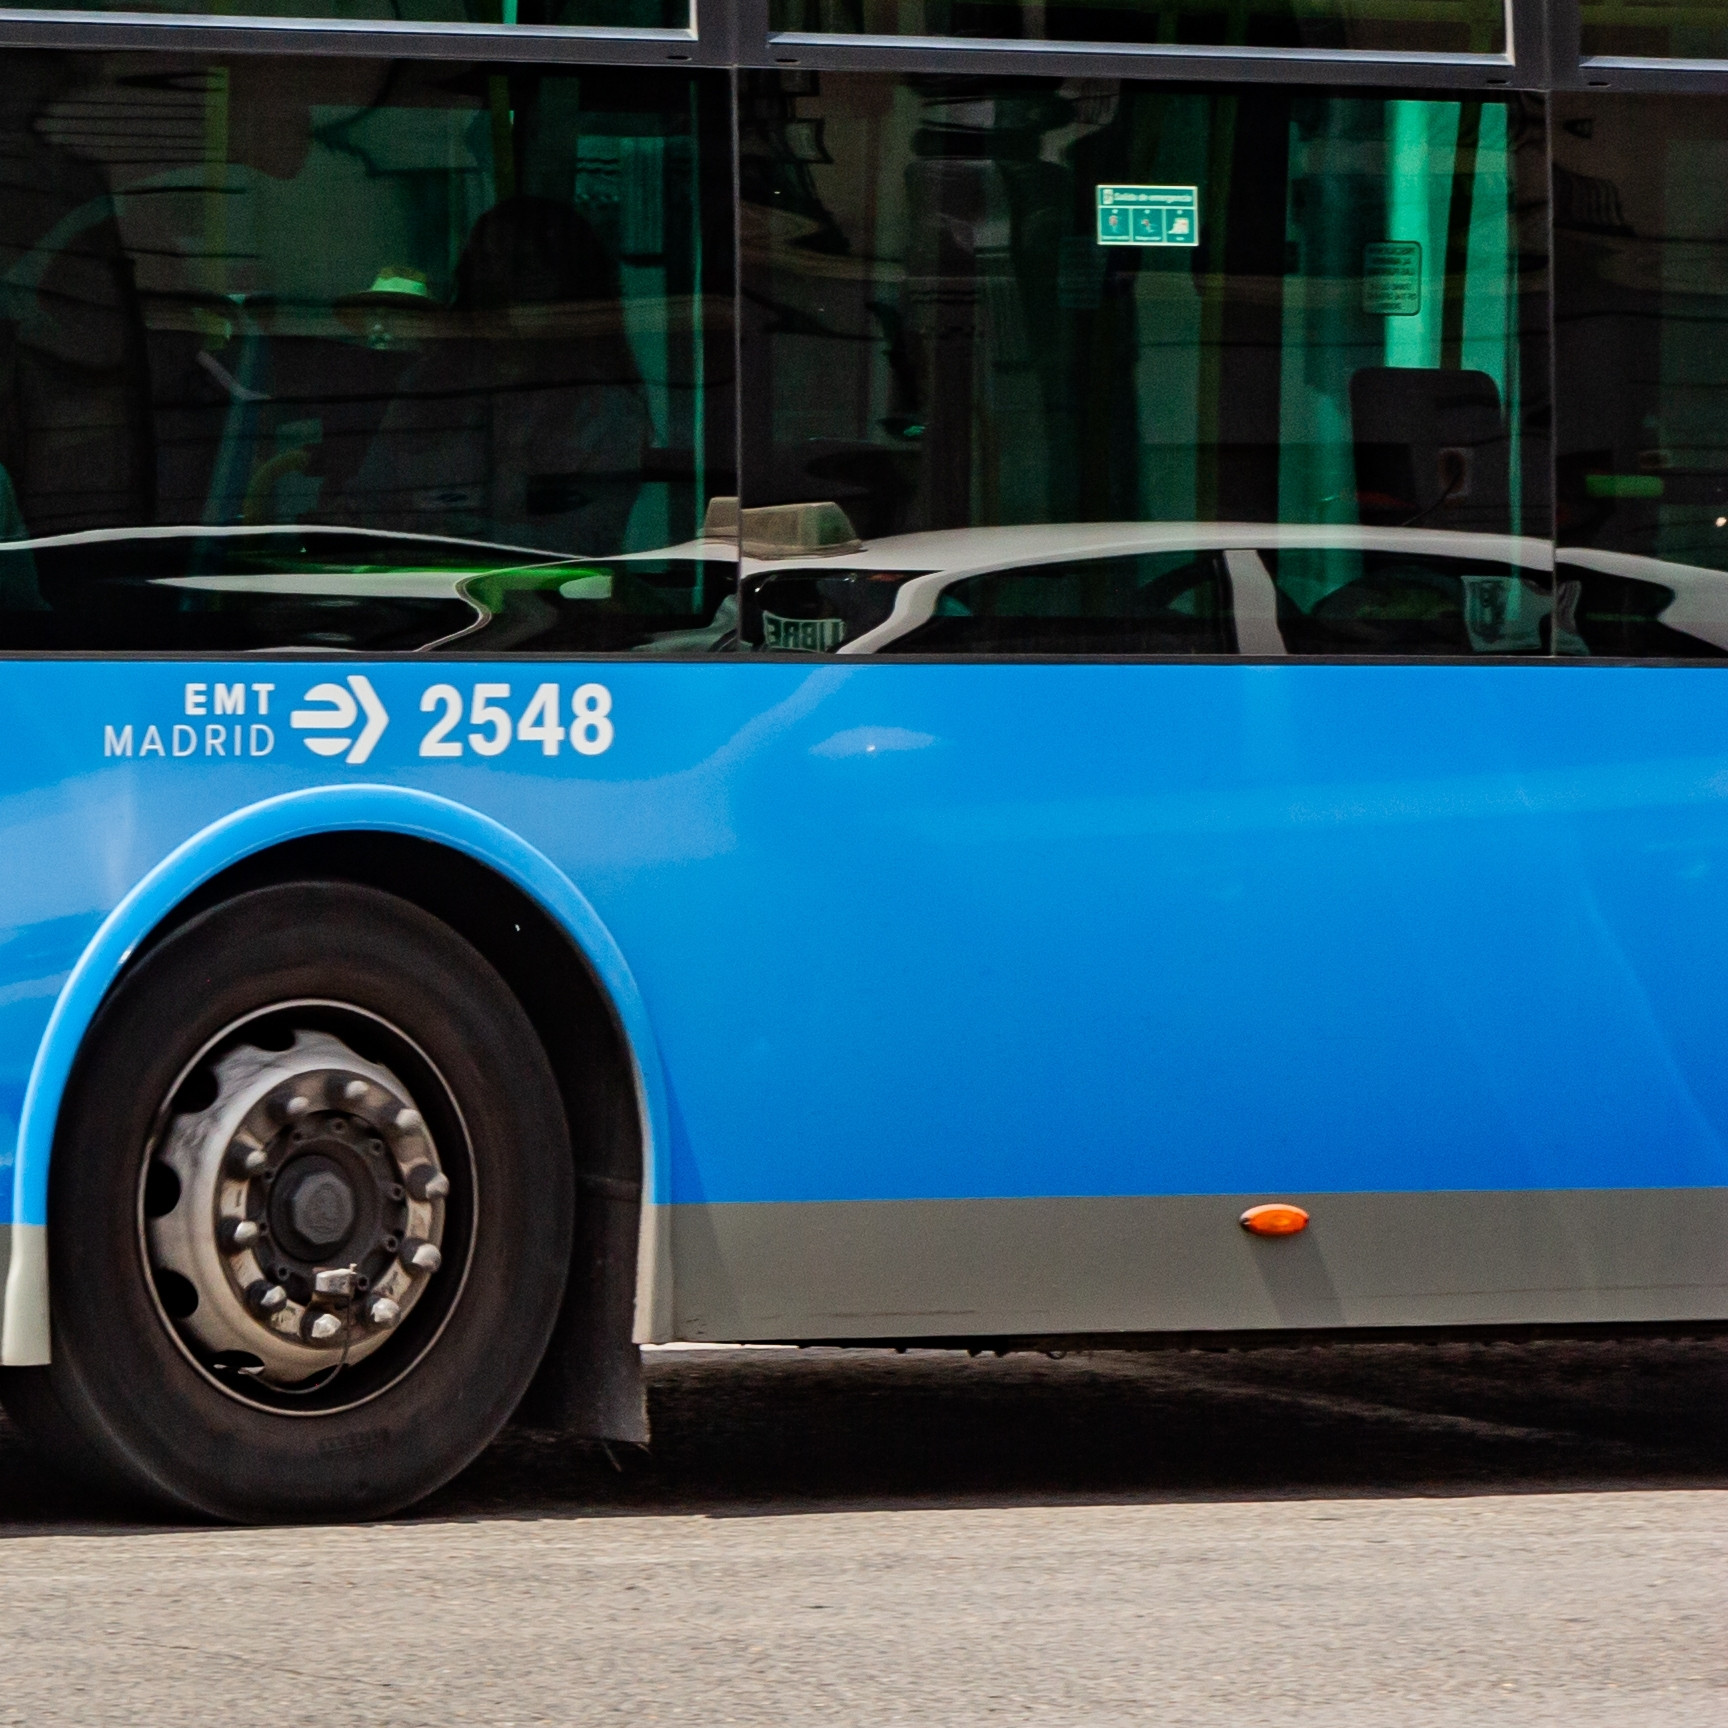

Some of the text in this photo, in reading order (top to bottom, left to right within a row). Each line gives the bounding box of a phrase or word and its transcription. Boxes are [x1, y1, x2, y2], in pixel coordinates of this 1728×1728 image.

[185, 682, 276, 716] EMT
[418, 682, 614, 758] 2548
[103, 723, 276, 758] MADRID
